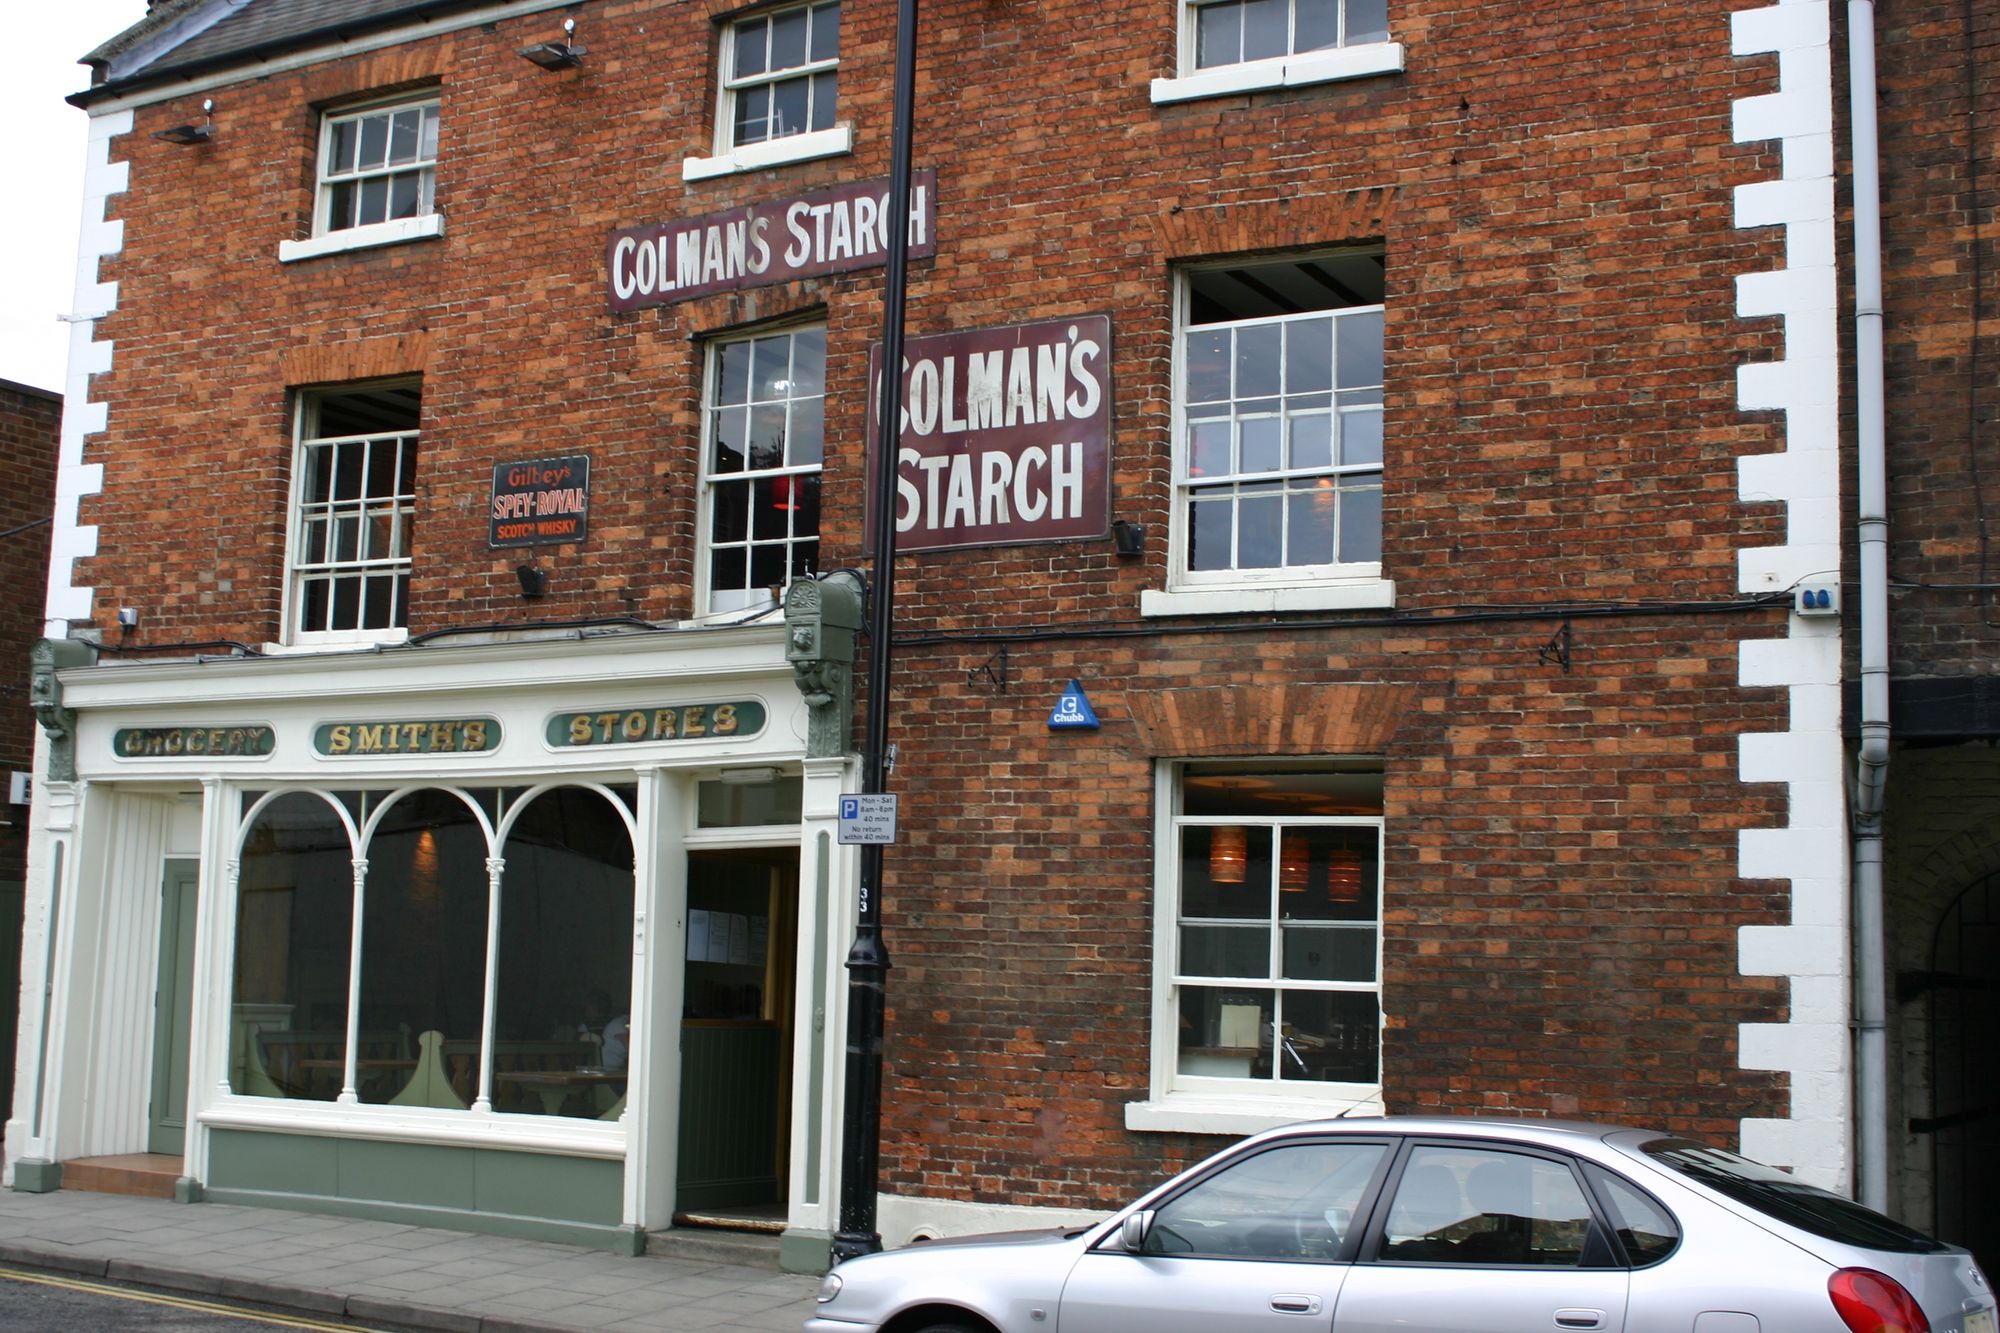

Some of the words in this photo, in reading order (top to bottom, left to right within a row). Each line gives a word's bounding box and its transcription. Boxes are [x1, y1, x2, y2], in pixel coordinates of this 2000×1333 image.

[613, 208, 771, 299] COLMAN'S
[896, 442, 1083, 533] STARCH
[497, 523, 535, 539] SCOTCH
[537, 519, 577, 536] WHISKY
[125, 728, 266, 754] GROCERY
[329, 720, 487, 754] SMITH'S
[569, 704, 738, 745] STORES
[1054, 713, 1084, 722] Chubb
[844, 801, 855, 818] P
